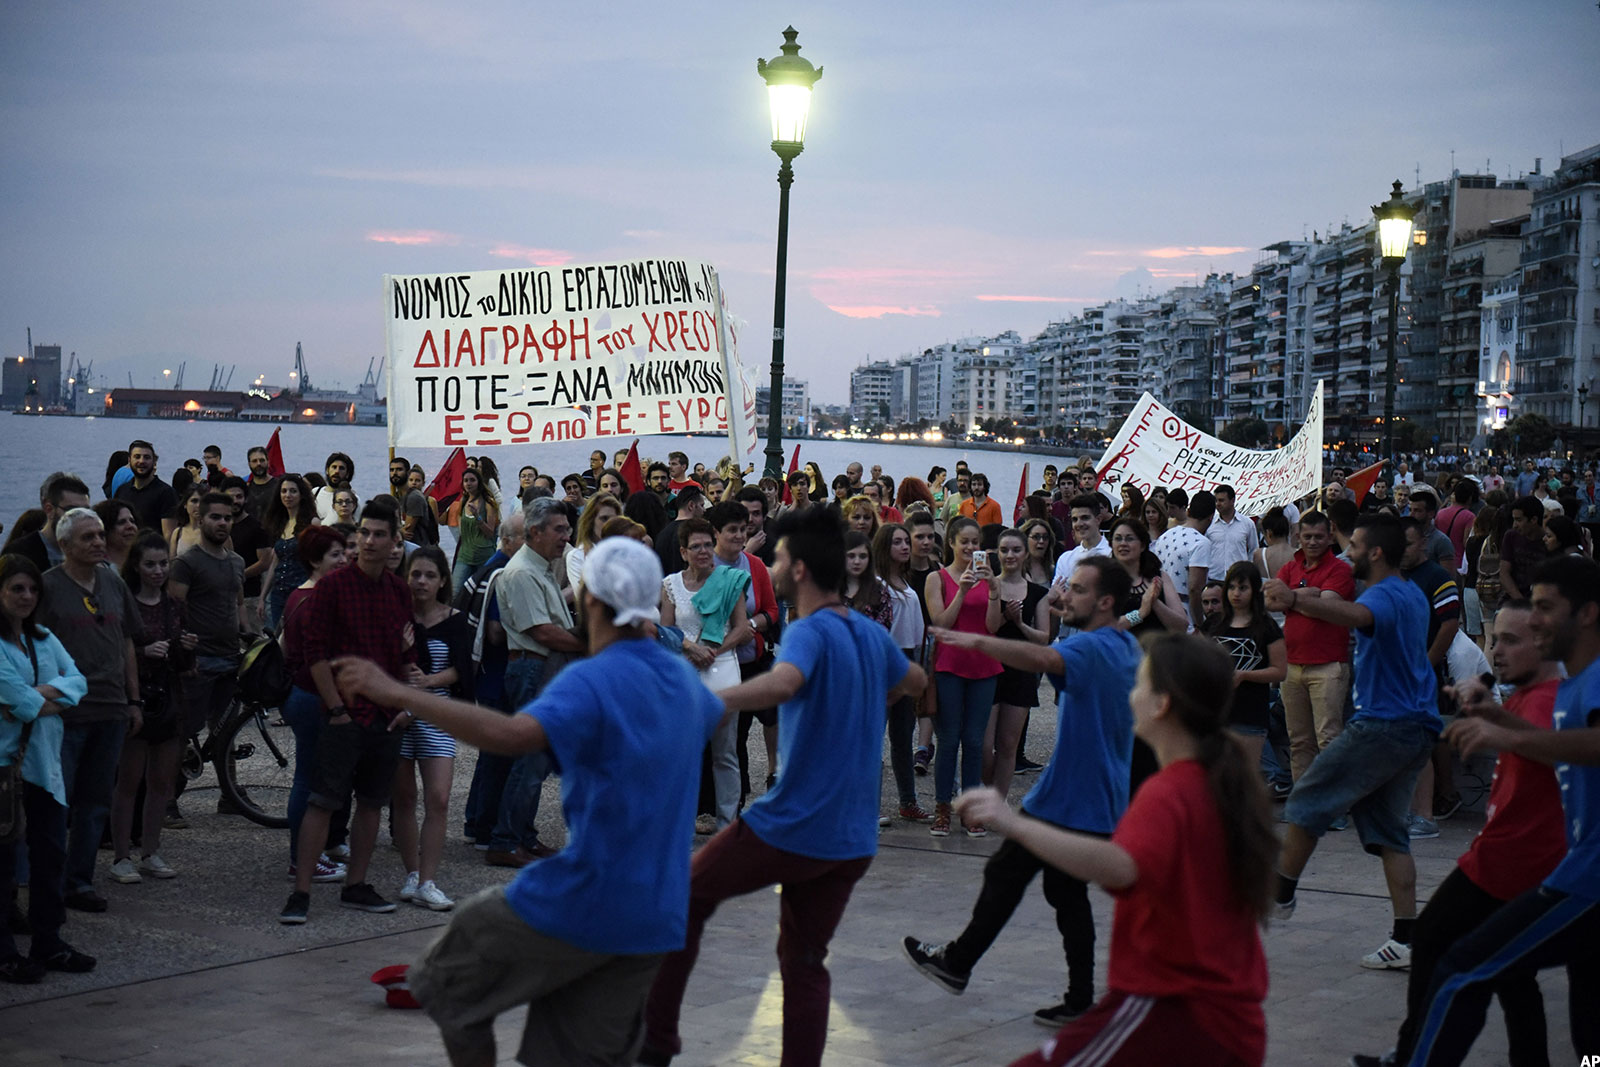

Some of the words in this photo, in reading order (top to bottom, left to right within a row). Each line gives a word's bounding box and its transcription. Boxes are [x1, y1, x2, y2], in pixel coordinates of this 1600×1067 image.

[393, 275, 473, 320] ΝΟΜΟΣ
[498, 270, 552, 317] ΔΙΚΙΟ
[562, 260, 693, 313] ΕΡΓΑΖΟΜΕΝΩΝ
[413, 317, 592, 368] ΔΙΑΓΡΑΦΗ
[641, 310, 720, 353] ΧΡΕΟΥ
[415, 374, 509, 412] ΠΟΤΕ
[527, 366, 613, 406] ΞΑΝΑ
[444, 411, 533, 445] ΕΞΩ
[541, 418, 586, 442] ΑΠΟ
[658, 396, 728, 431] ΕΥΡΩ
[1162, 416, 1202, 450] ΟΧΙ
